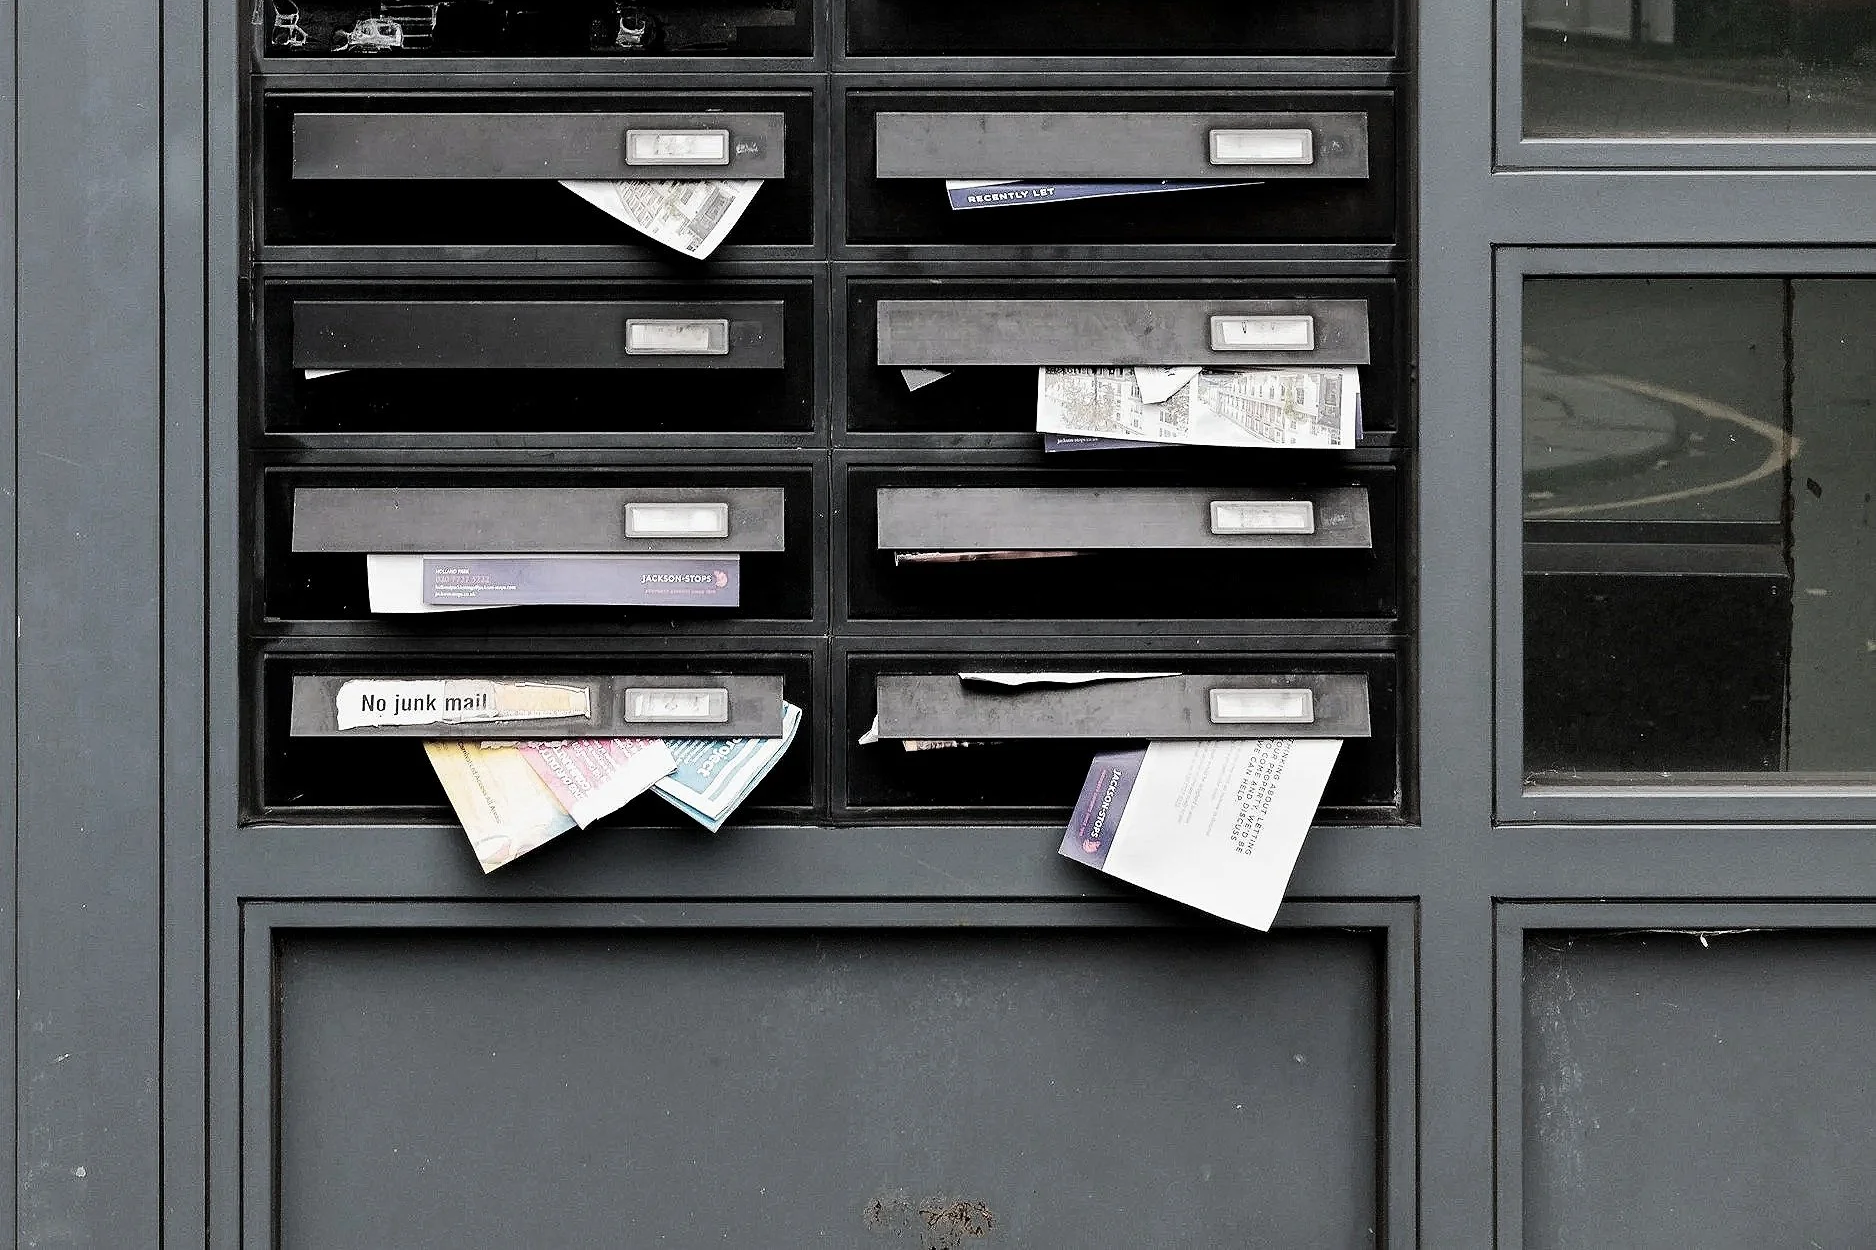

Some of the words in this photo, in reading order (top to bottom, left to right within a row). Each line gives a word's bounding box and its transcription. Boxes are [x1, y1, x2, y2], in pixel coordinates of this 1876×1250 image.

[966, 190, 1029, 203] RECENTLY
[1032, 187, 1055, 197] LET
[361, 694, 387, 712] No
[393, 693, 437, 716] junk
[445, 693, 487, 711] mail
[1245, 756, 1257, 776] CAN
[1254, 752, 1269, 778] COME
[1246, 780, 1258, 800] AND
[1260, 783, 1276, 815] ABOUT
[1230, 802, 1250, 841] DISCUSS
[1235, 840, 1245, 854] BE
[1244, 817, 1264, 856] LETTING
